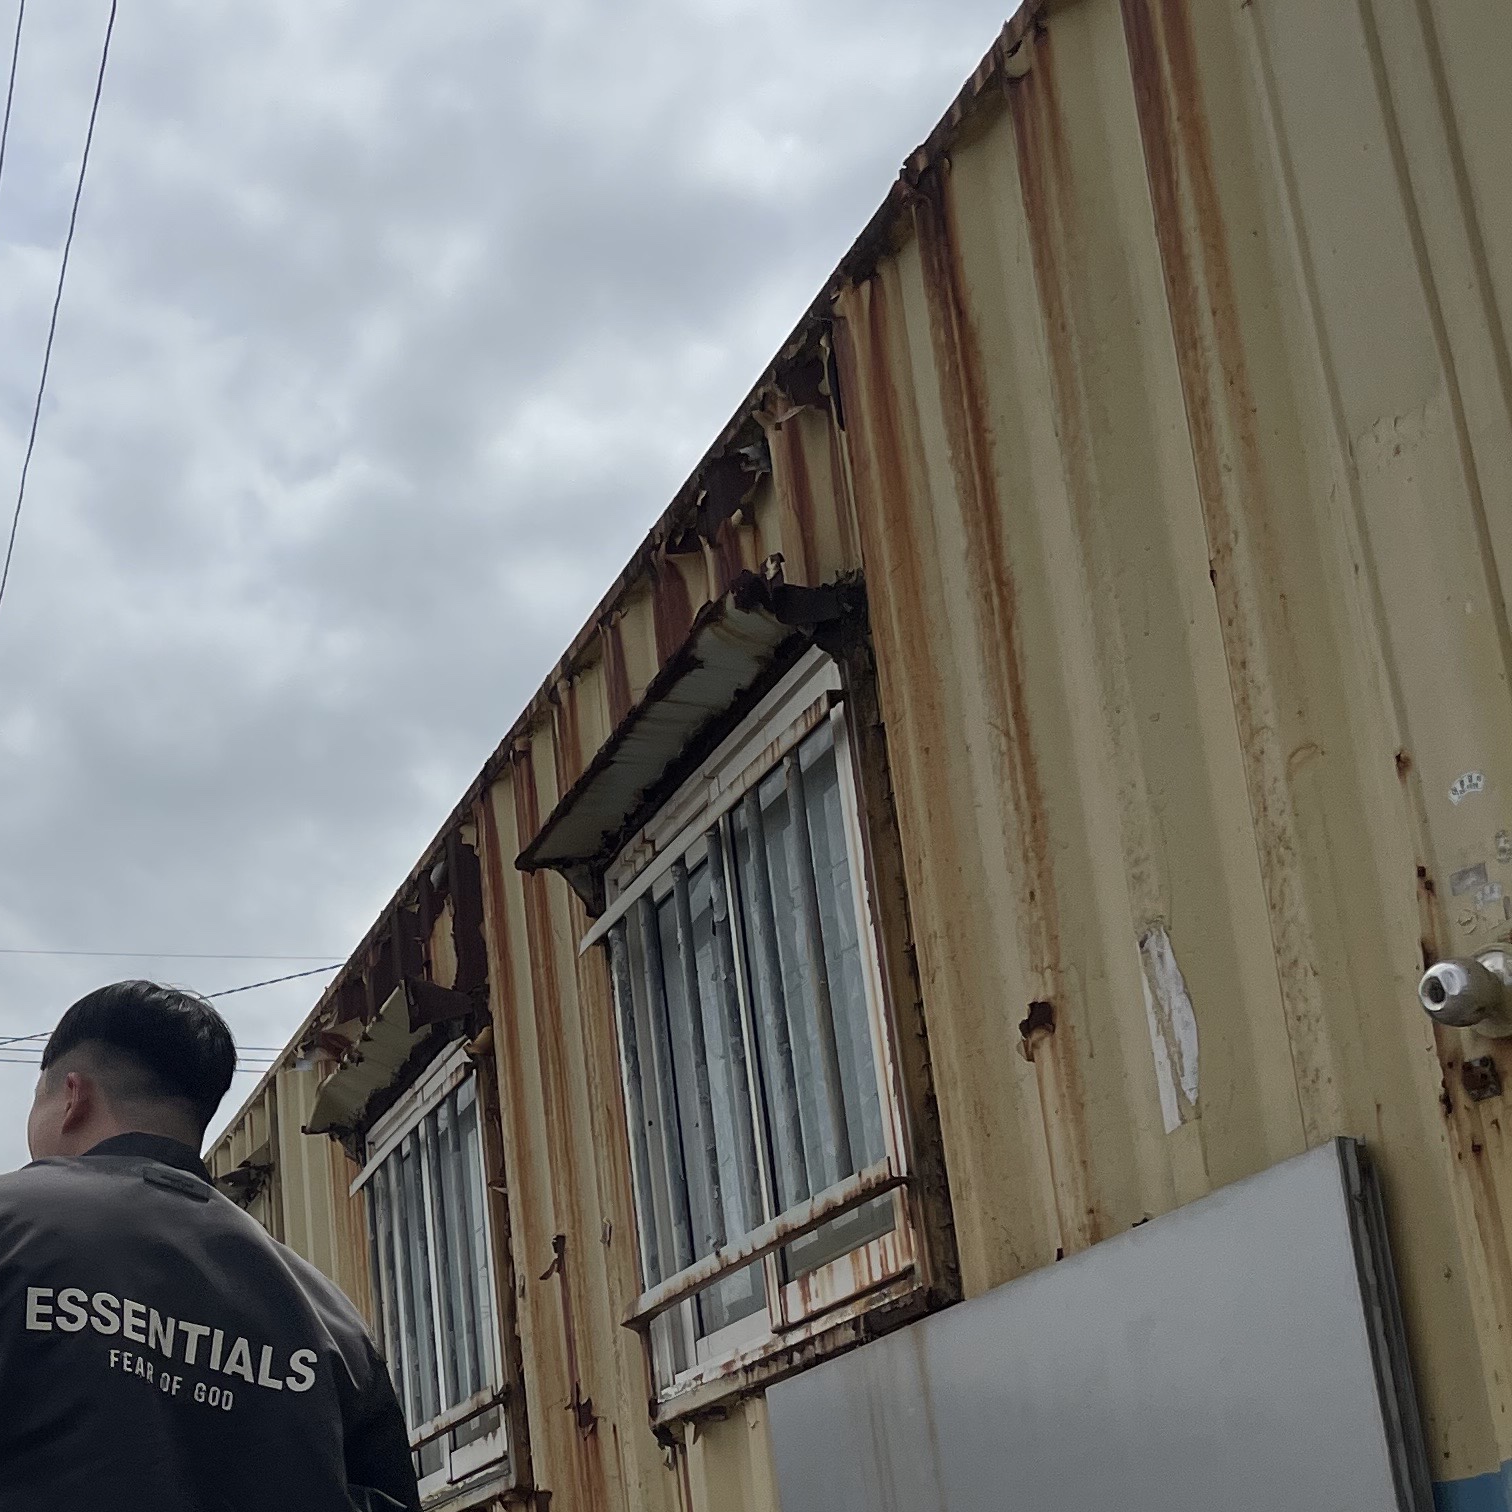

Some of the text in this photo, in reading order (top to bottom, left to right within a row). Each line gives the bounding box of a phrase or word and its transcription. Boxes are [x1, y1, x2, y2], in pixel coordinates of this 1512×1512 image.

[26, 1286, 318, 1392] ESSENTIALS
[109, 1348, 234, 1411] FEAR OF GOD
